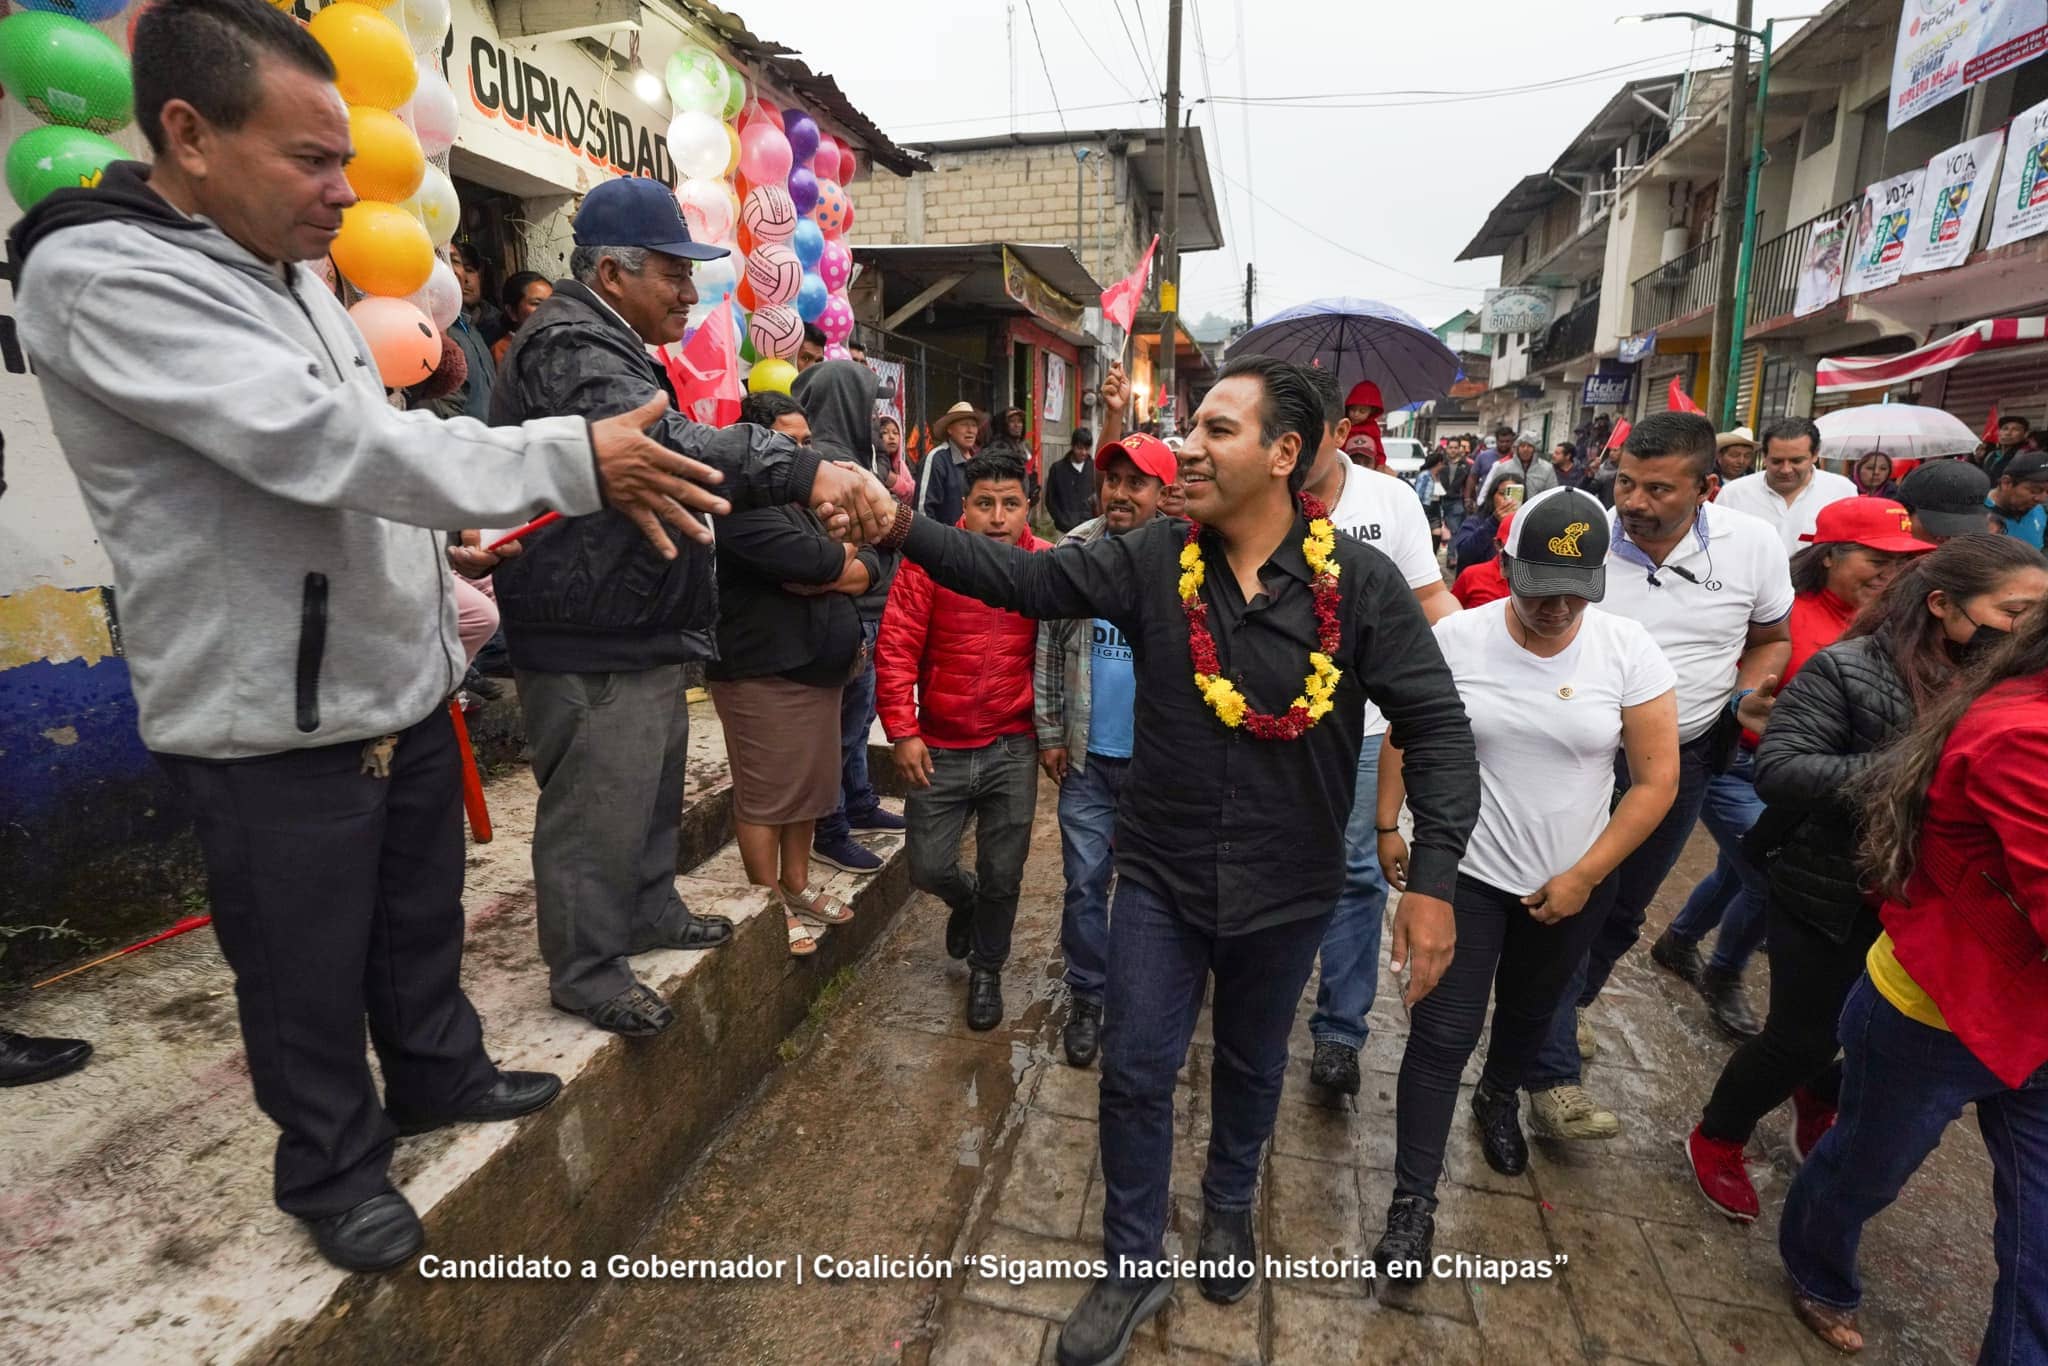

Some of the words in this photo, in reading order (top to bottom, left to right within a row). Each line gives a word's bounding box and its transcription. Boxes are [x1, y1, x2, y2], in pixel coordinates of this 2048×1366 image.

[1919, 4, 1955, 35] PPCH
[1946, 152, 1976, 176] VOTA
[1886, 182, 1914, 206] VOTA
[1593, 377, 1628, 393] telcel
